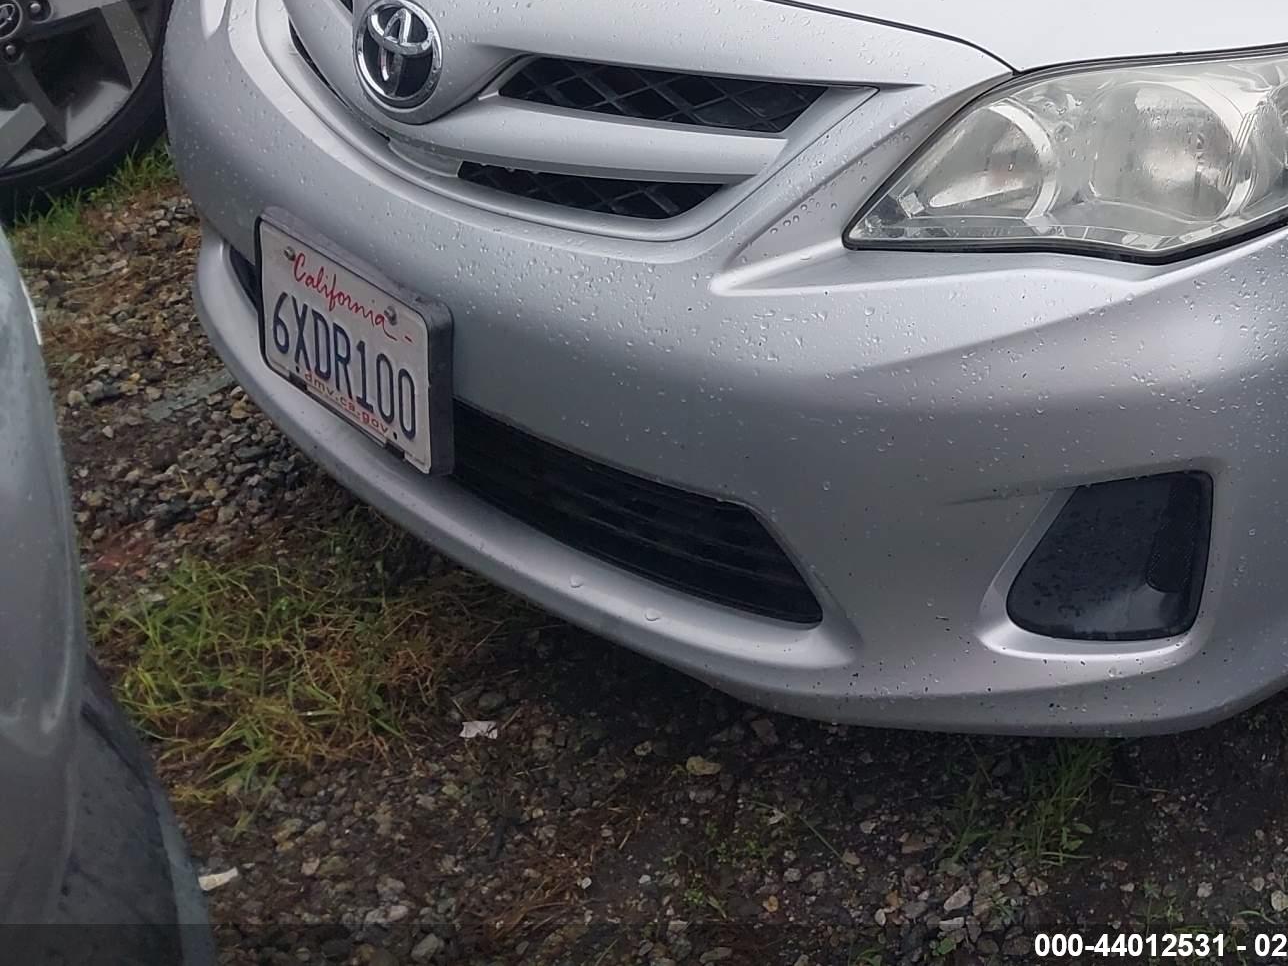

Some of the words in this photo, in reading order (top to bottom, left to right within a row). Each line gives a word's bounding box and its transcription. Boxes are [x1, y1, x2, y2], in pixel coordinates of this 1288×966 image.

[293, 252, 397, 341] California
[272, 291, 416, 441] 6XDR100
[304, 370, 389, 434] dmv.ca.gov
